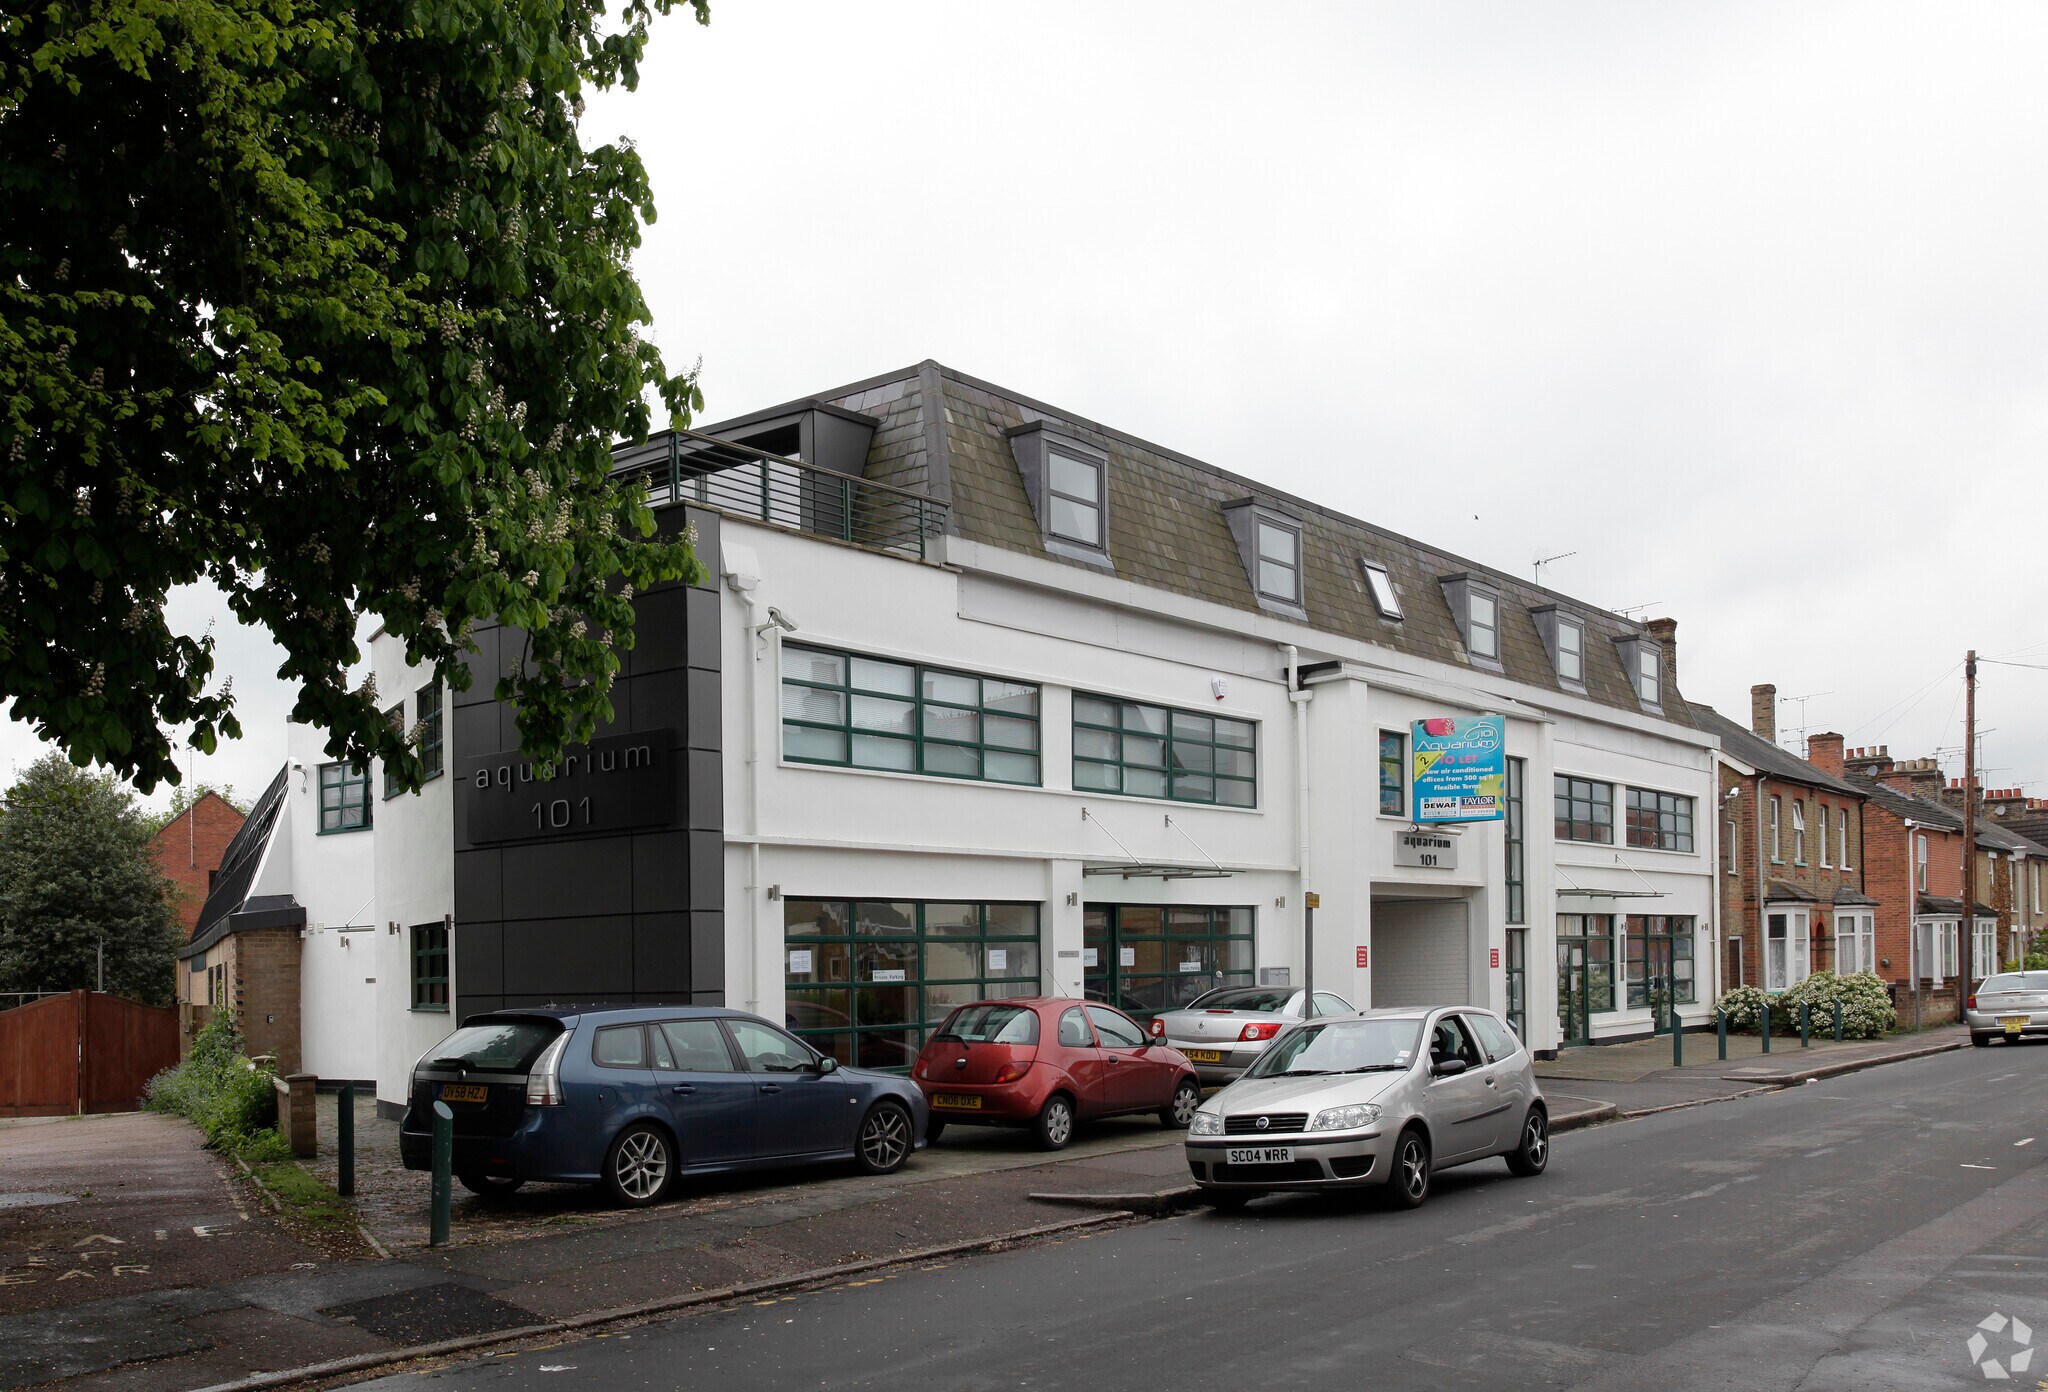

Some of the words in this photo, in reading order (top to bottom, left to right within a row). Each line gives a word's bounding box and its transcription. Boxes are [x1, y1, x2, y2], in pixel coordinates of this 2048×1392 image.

[1416, 740, 1494, 751] Aquarium
[1420, 757, 1429, 765] 2
[1440, 755, 1455, 764] TO
[1458, 753, 1478, 764] LET
[475, 745, 651, 792] aquarium
[1452, 766, 1494, 774] conditioned
[1462, 796, 1494, 805] TAYLOR
[531, 796, 592, 830] 101
[1403, 835, 1451, 849] aquarium
[1420, 853, 1437, 866] 101
[1200, 1051, 1217, 1060] KDU
[467, 1086, 488, 1100] HZJ
[1231, 1149, 1261, 1163] SC04
[1264, 1148, 1289, 1162] WRR
